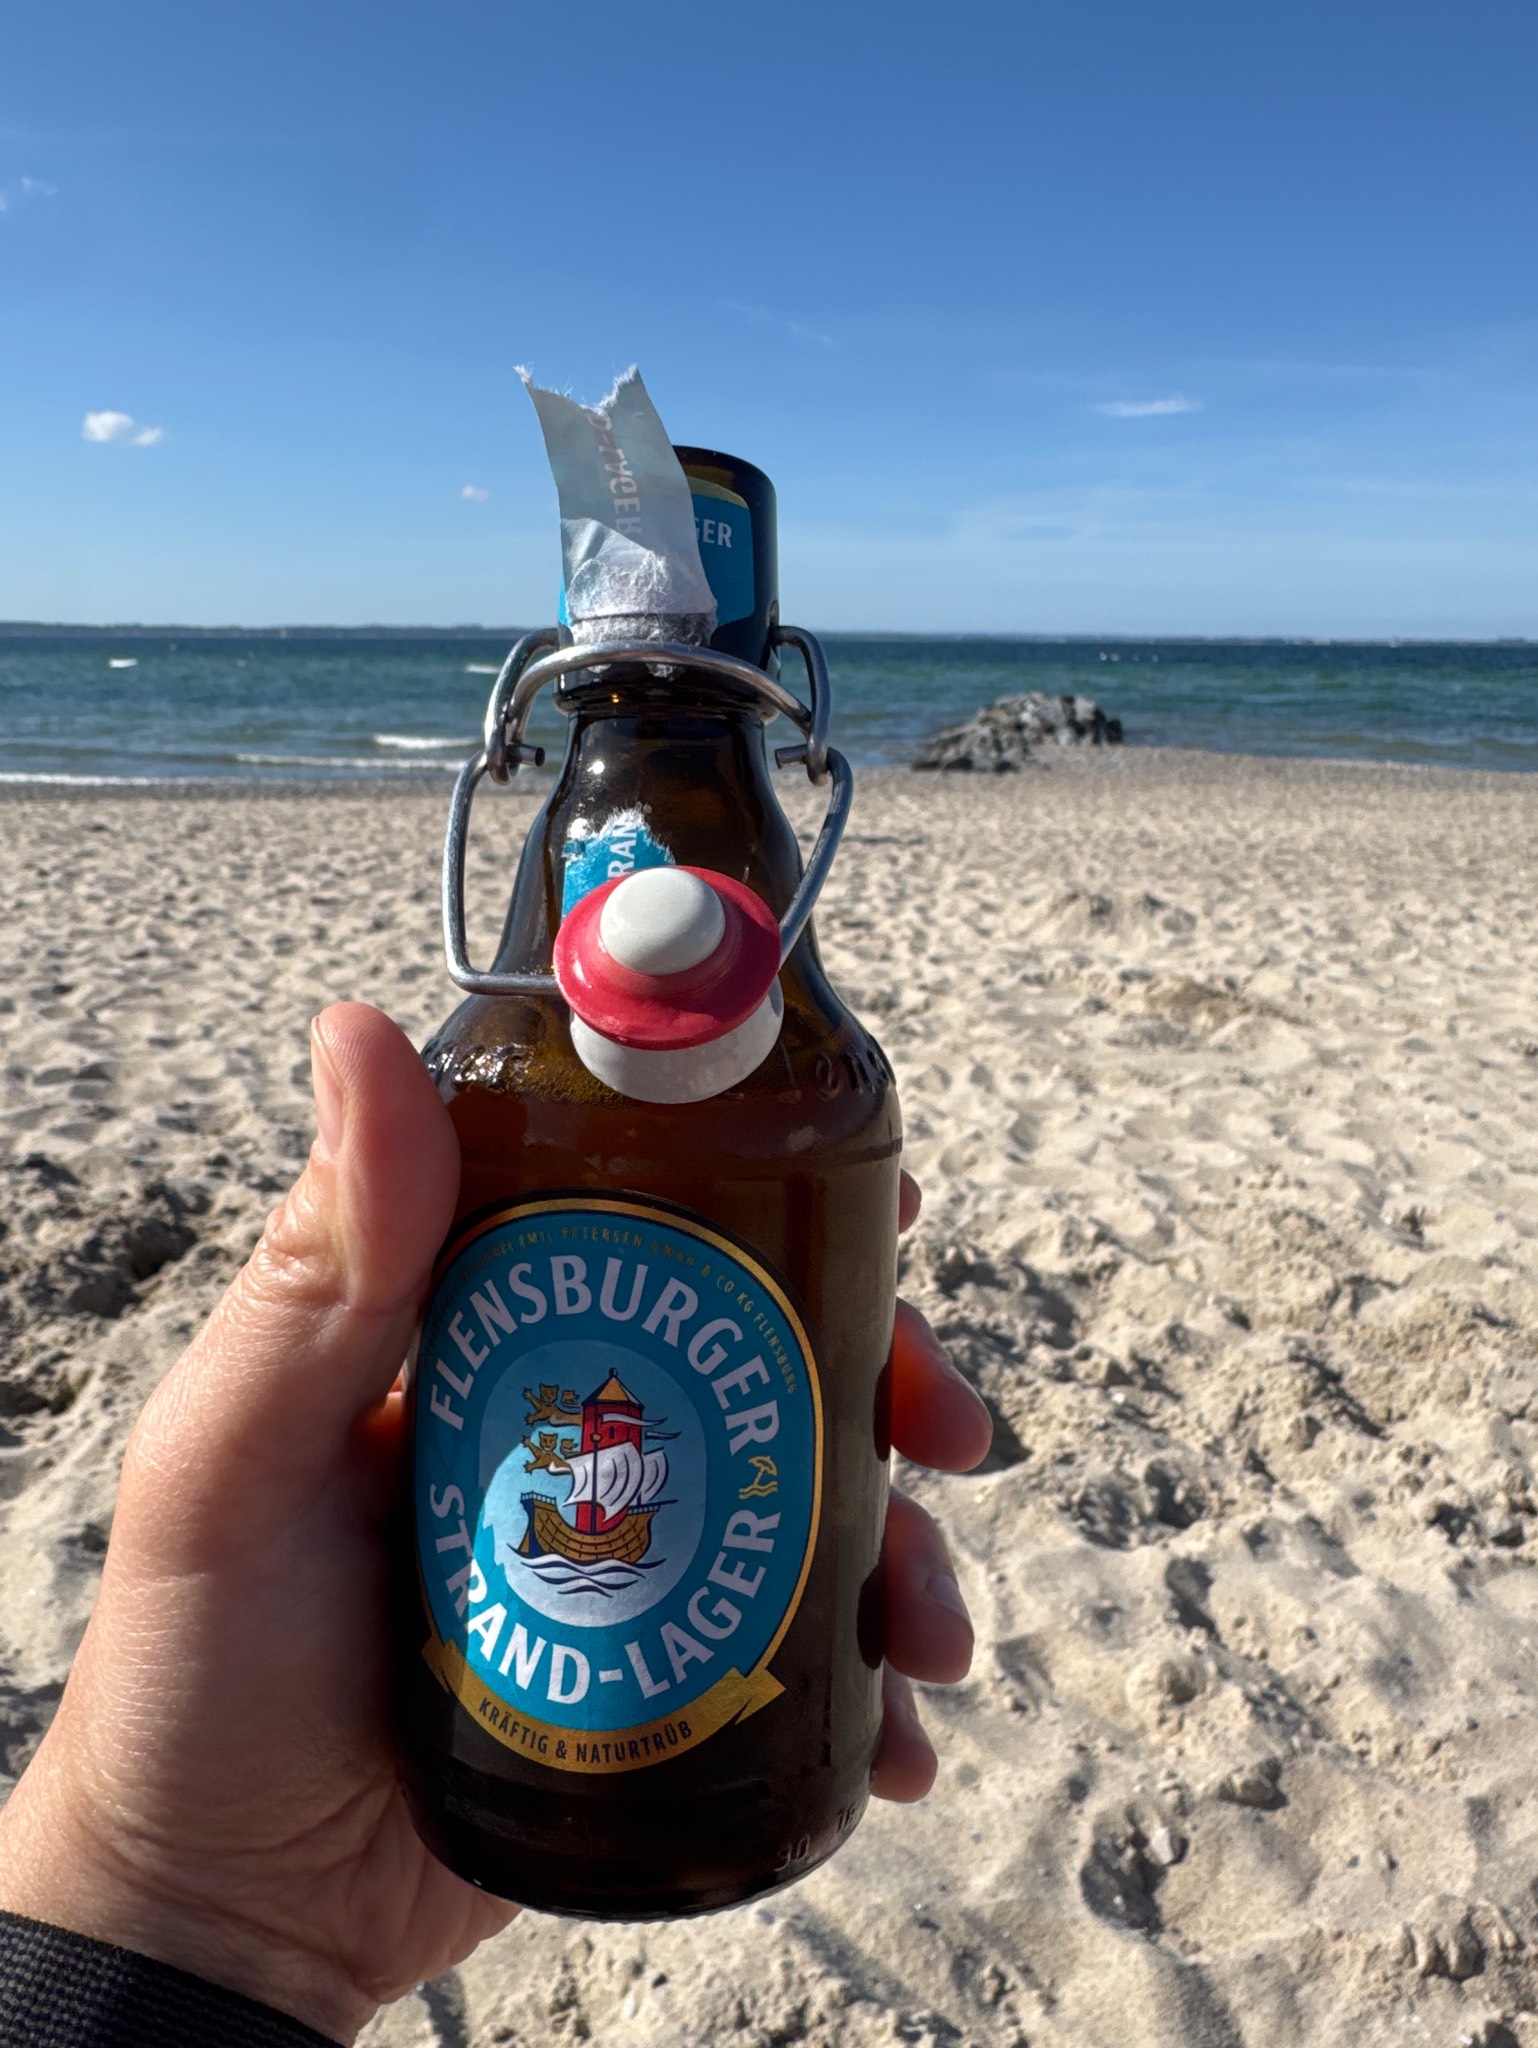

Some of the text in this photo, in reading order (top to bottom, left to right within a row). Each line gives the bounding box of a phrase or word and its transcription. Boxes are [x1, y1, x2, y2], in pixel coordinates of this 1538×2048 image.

[430, 1254, 780, 1457] FLENSBURGER
[430, 1483, 781, 1705] STRAND-LAGER
[478, 1697, 693, 1764] KRÄFTIG & NATURTRÜB
